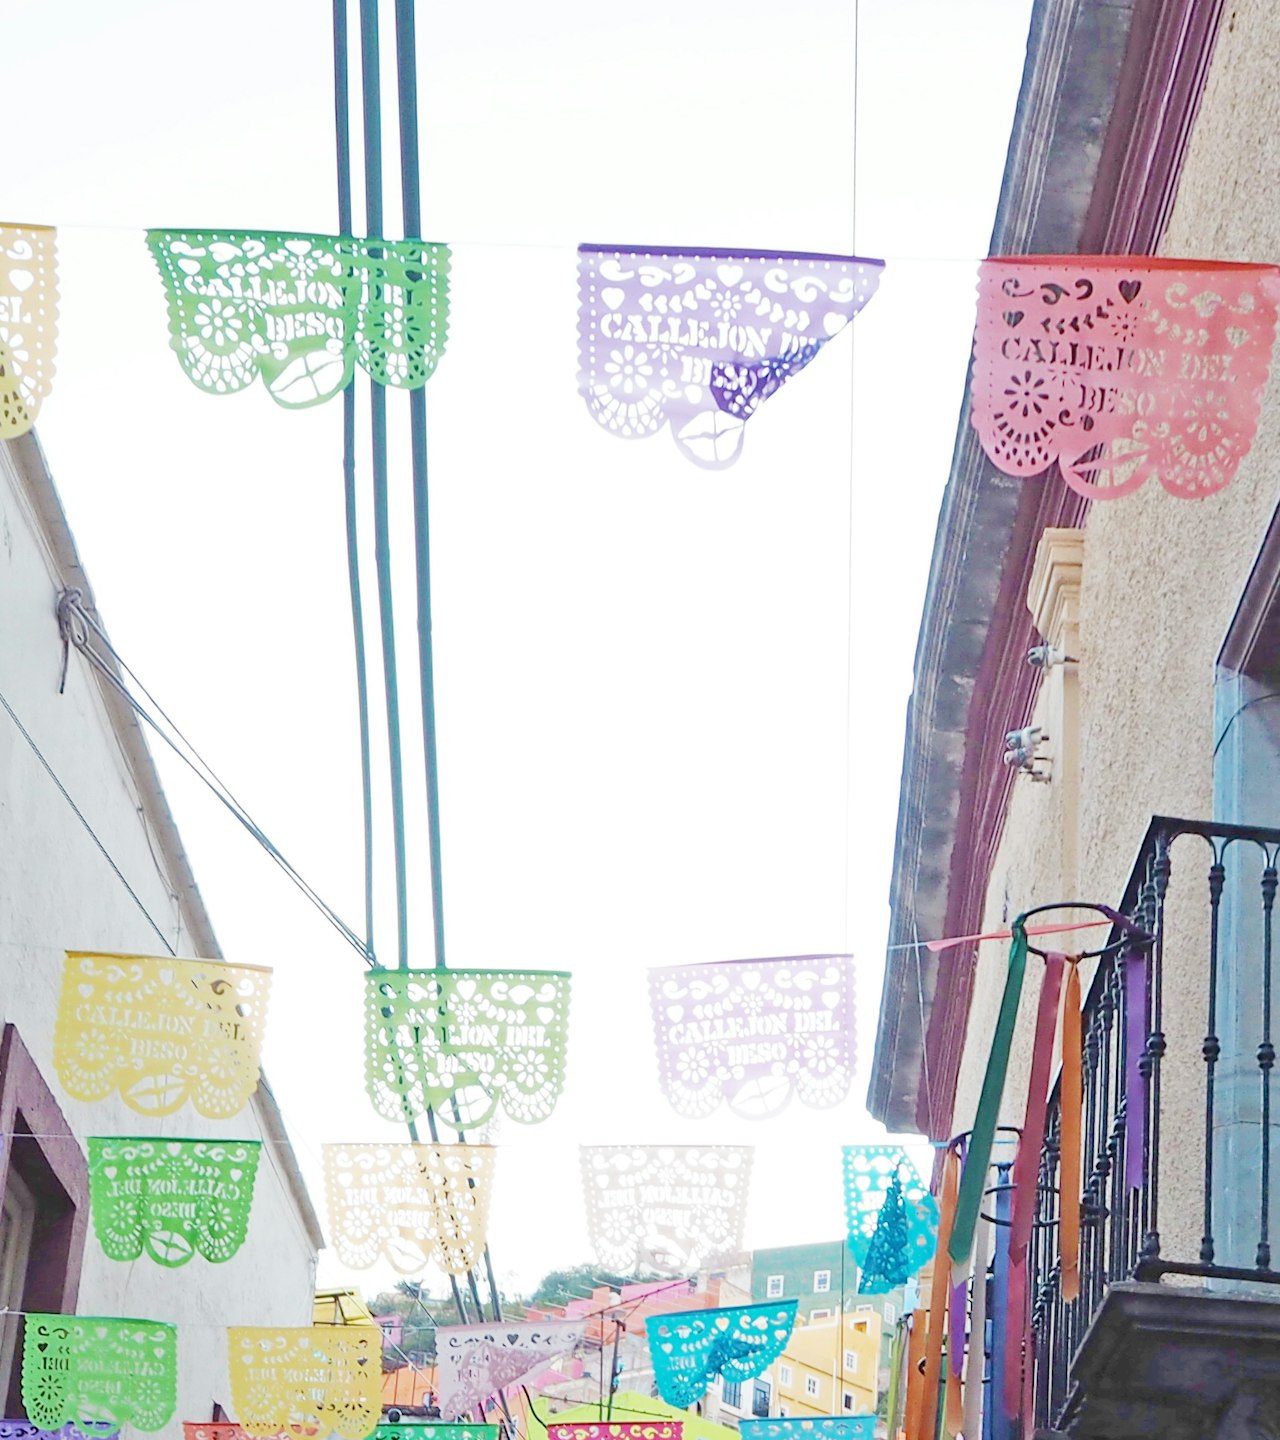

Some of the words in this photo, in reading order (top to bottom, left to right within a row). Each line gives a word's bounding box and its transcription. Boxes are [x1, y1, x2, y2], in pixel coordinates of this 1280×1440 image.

[184, 275, 347, 310] CALLEJON
[361, 283, 422, 306] DEL
[265, 311, 345, 341] BESO
[600, 313, 772, 358] CALLEJON
[1001, 337, 1167, 378] CALLEJON
[1178, 352, 1237, 383] DEL
[1079, 383, 1155, 416] BESO
[75, 1002, 196, 1034] CALLEJON
[202, 1019, 246, 1041] DEL
[378, 1024, 499, 1047] CALLEJON
[506, 1025, 551, 1047] DEL
[669, 1012, 788, 1045] CALLEJON
[794, 1009, 840, 1033] DEL
[130, 1039, 188, 1060] BESO
[726, 1042, 787, 1066] BESO
